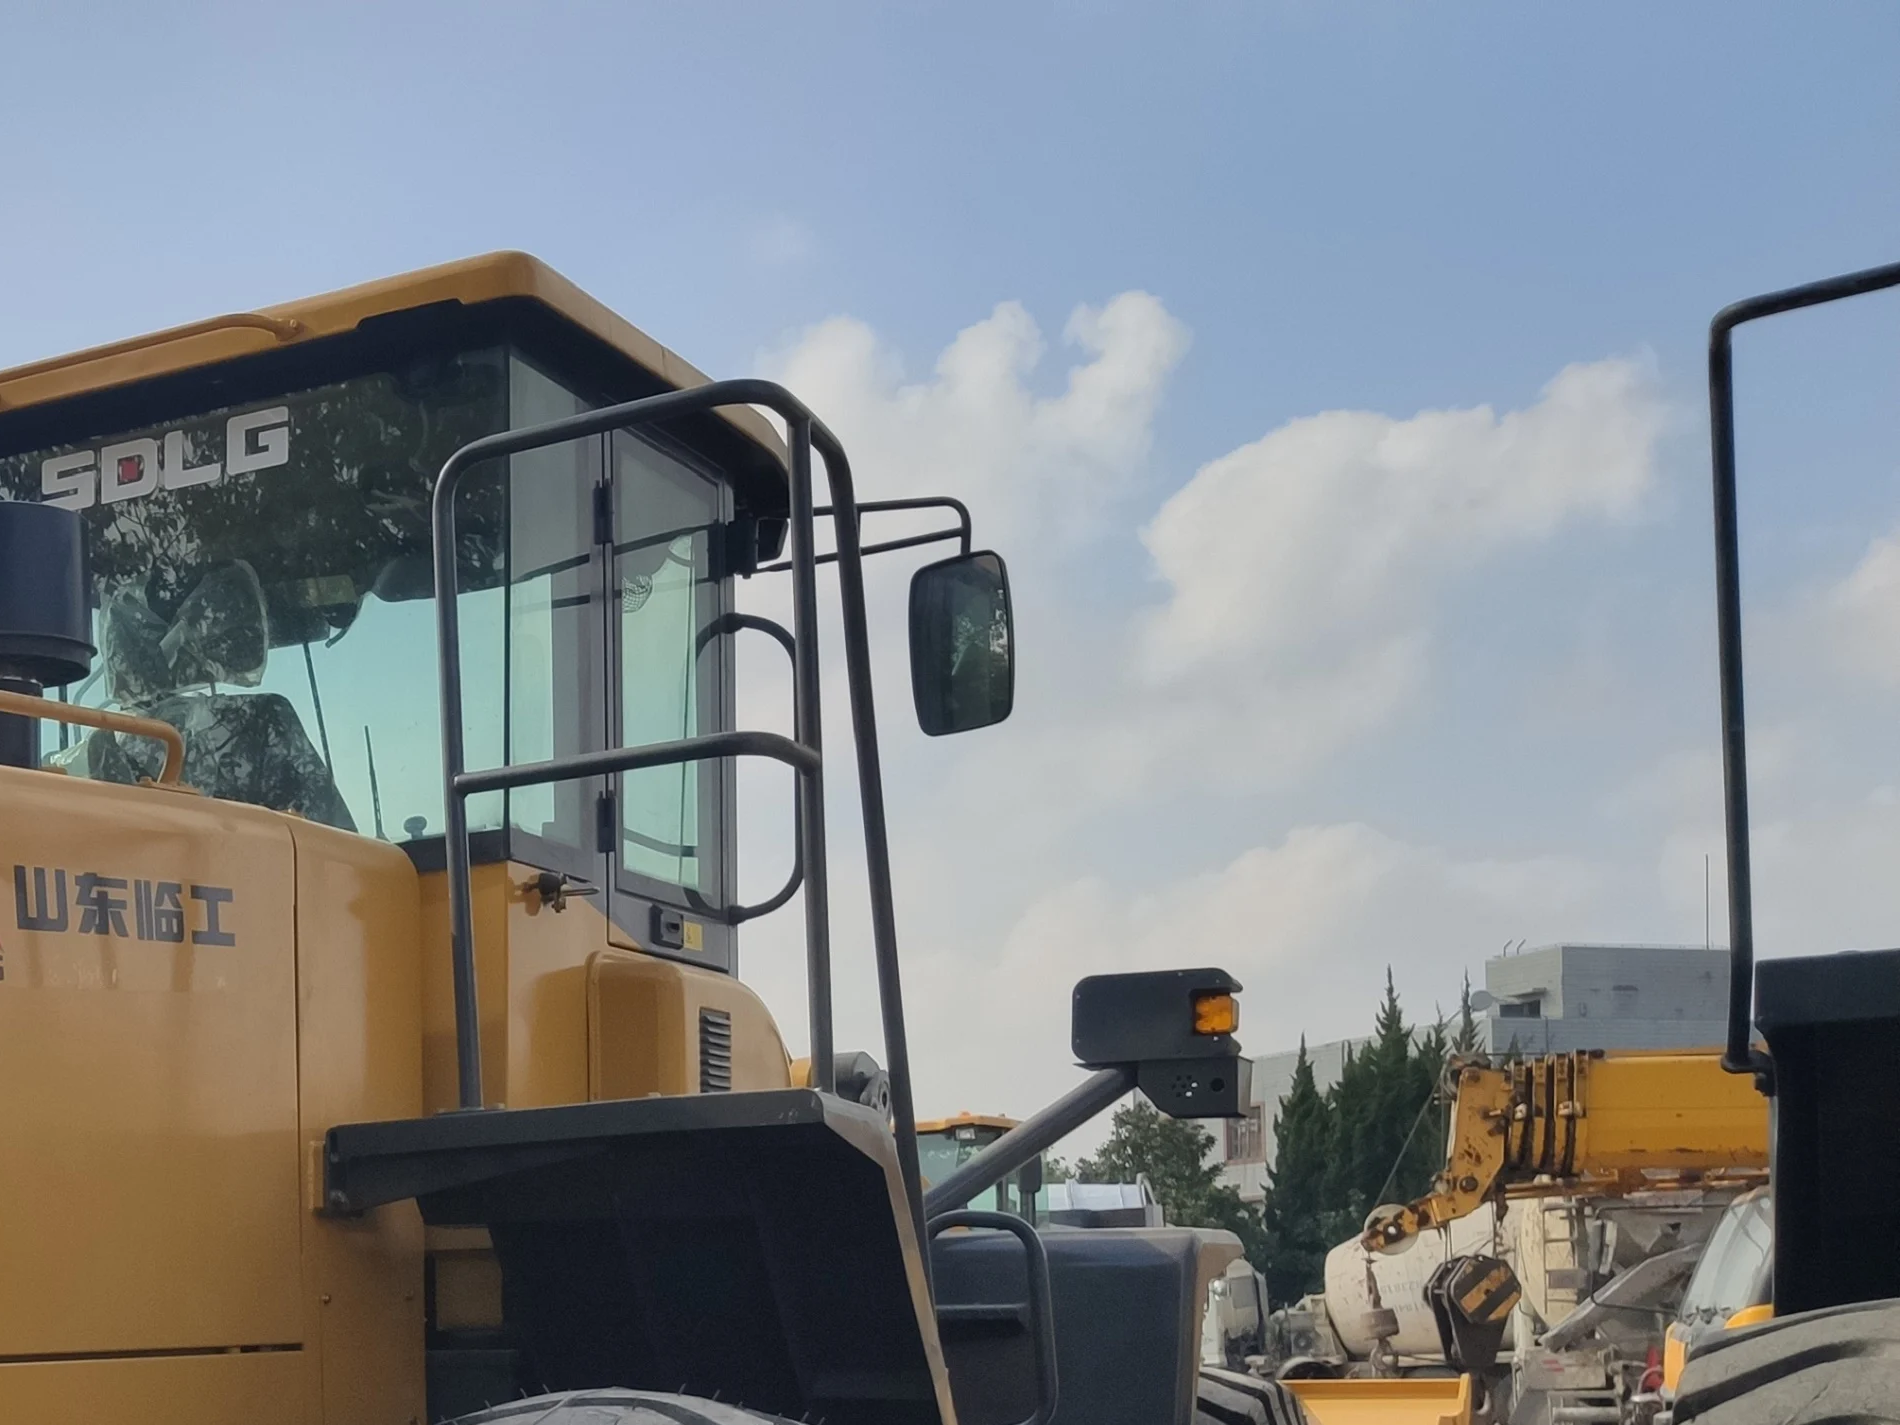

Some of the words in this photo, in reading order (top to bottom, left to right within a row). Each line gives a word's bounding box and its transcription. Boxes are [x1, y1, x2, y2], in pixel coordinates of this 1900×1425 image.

[41, 406, 289, 511] SDLG
[13, 864, 236, 947] 山东临工
